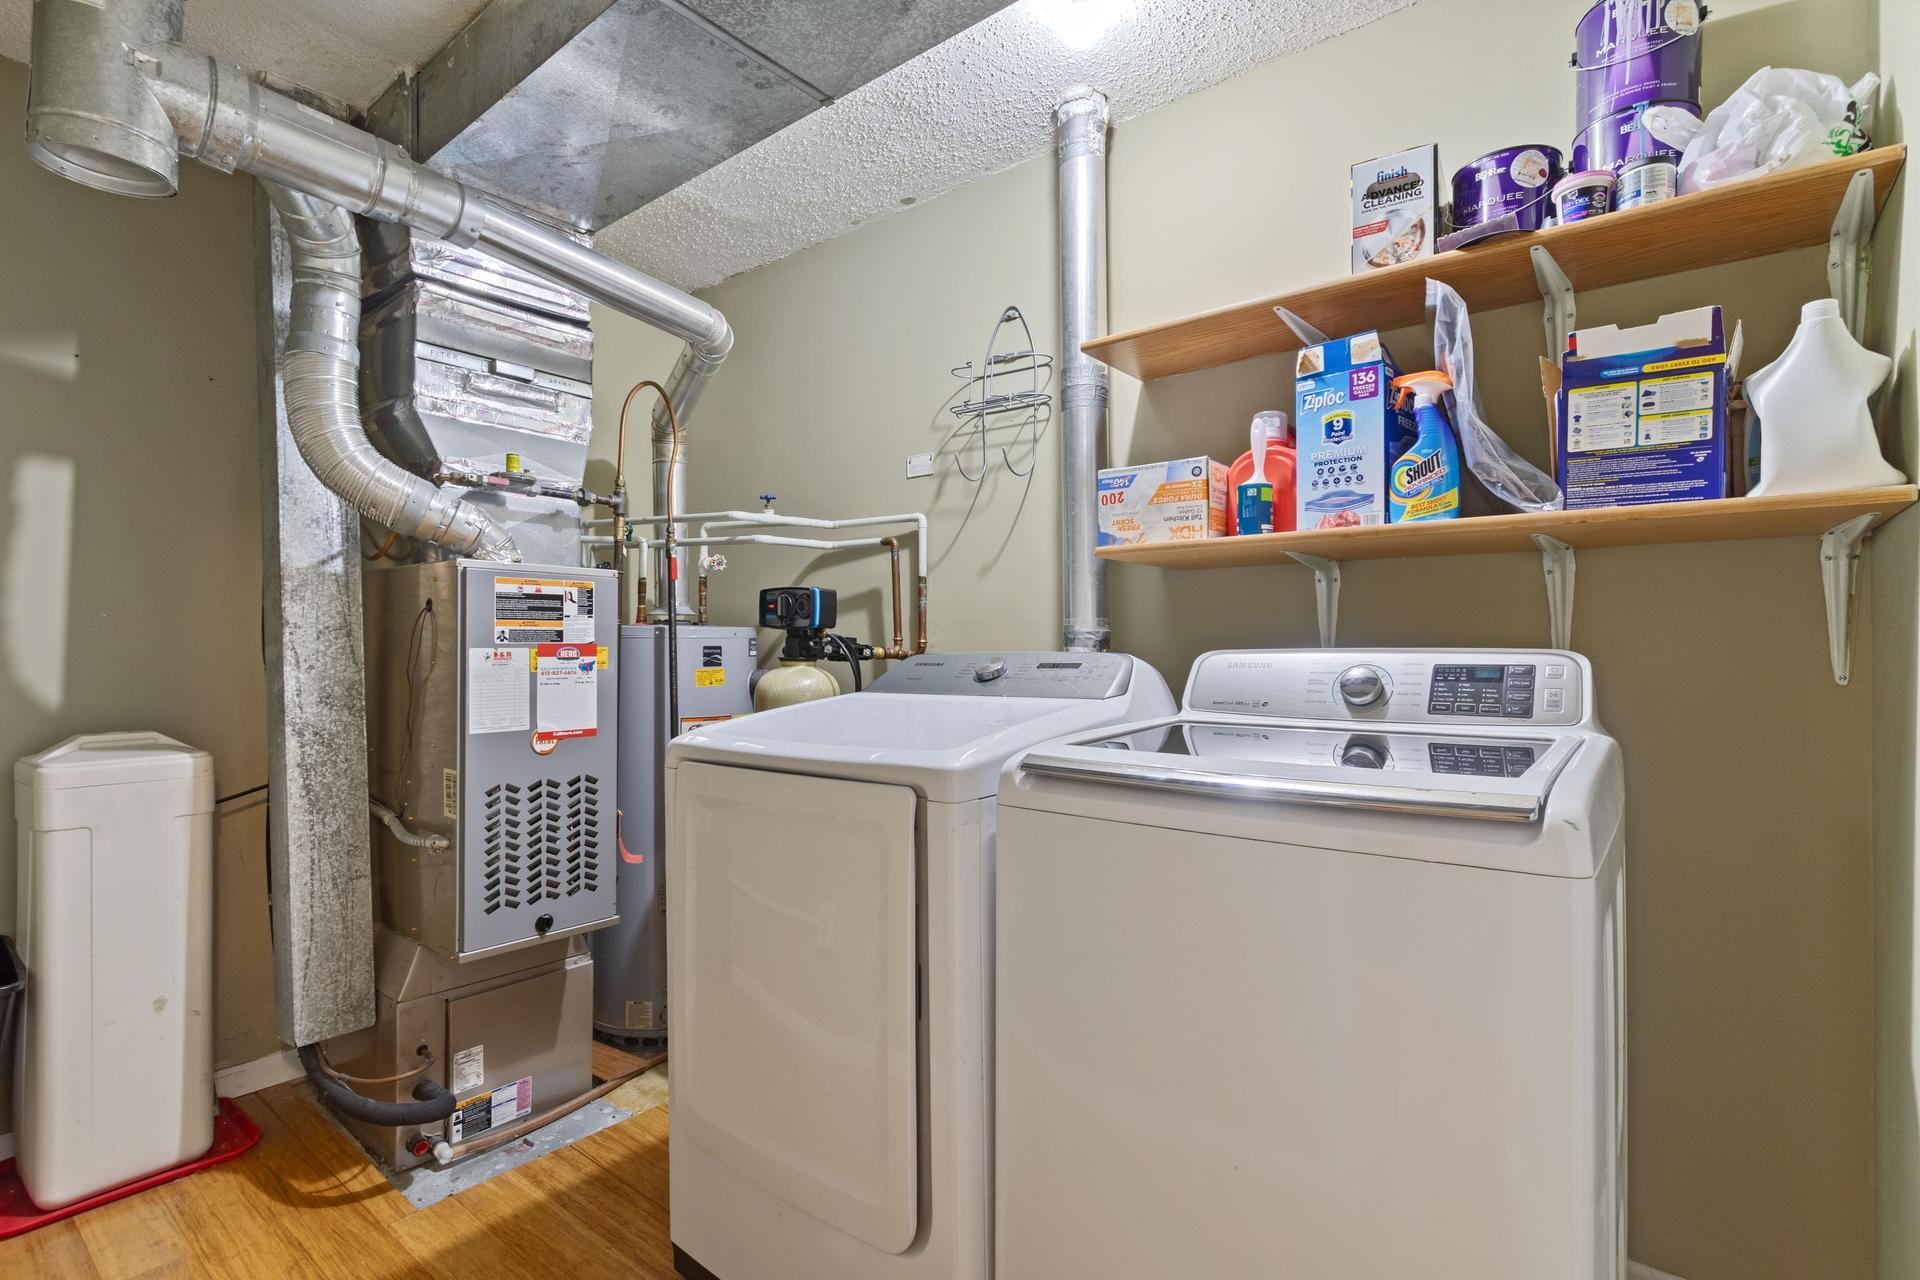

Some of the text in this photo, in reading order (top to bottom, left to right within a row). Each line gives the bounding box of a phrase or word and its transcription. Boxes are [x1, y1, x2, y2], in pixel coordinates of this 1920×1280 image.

[1596, 25, 1668, 58] MARUEE
[1377, 166, 1408, 184] finish
[1361, 179, 1424, 202] ADVANCED
[1363, 188, 1423, 210] CLEANING
[1463, 191, 1525, 216] MARQUEE
[1671, 360, 1696, 368] EVERY
[1352, 372, 1376, 386] 136
[1353, 383, 1376, 391] FREEZER
[1303, 391, 1345, 412] Ziploc
[1332, 417, 1344, 430] 9
[1398, 415, 1418, 432] FREEZ
[1331, 429, 1346, 437] Point
[1311, 445, 1369, 460] PREMIUM
[1314, 455, 1363, 468] PROTECTION
[1406, 449, 1443, 485] SHOUT
[1101, 491, 1124, 506] 200
[1152, 495, 1178, 504] FORCE
[1179, 492, 1203, 502] DURA
[1111, 517, 1136, 527] SCENT
[1163, 514, 1203, 522] Tall Kitchen
[1117, 523, 1141, 533] FRESH
[1169, 523, 1203, 540] HDX
[560, 650, 578, 658] HERO
